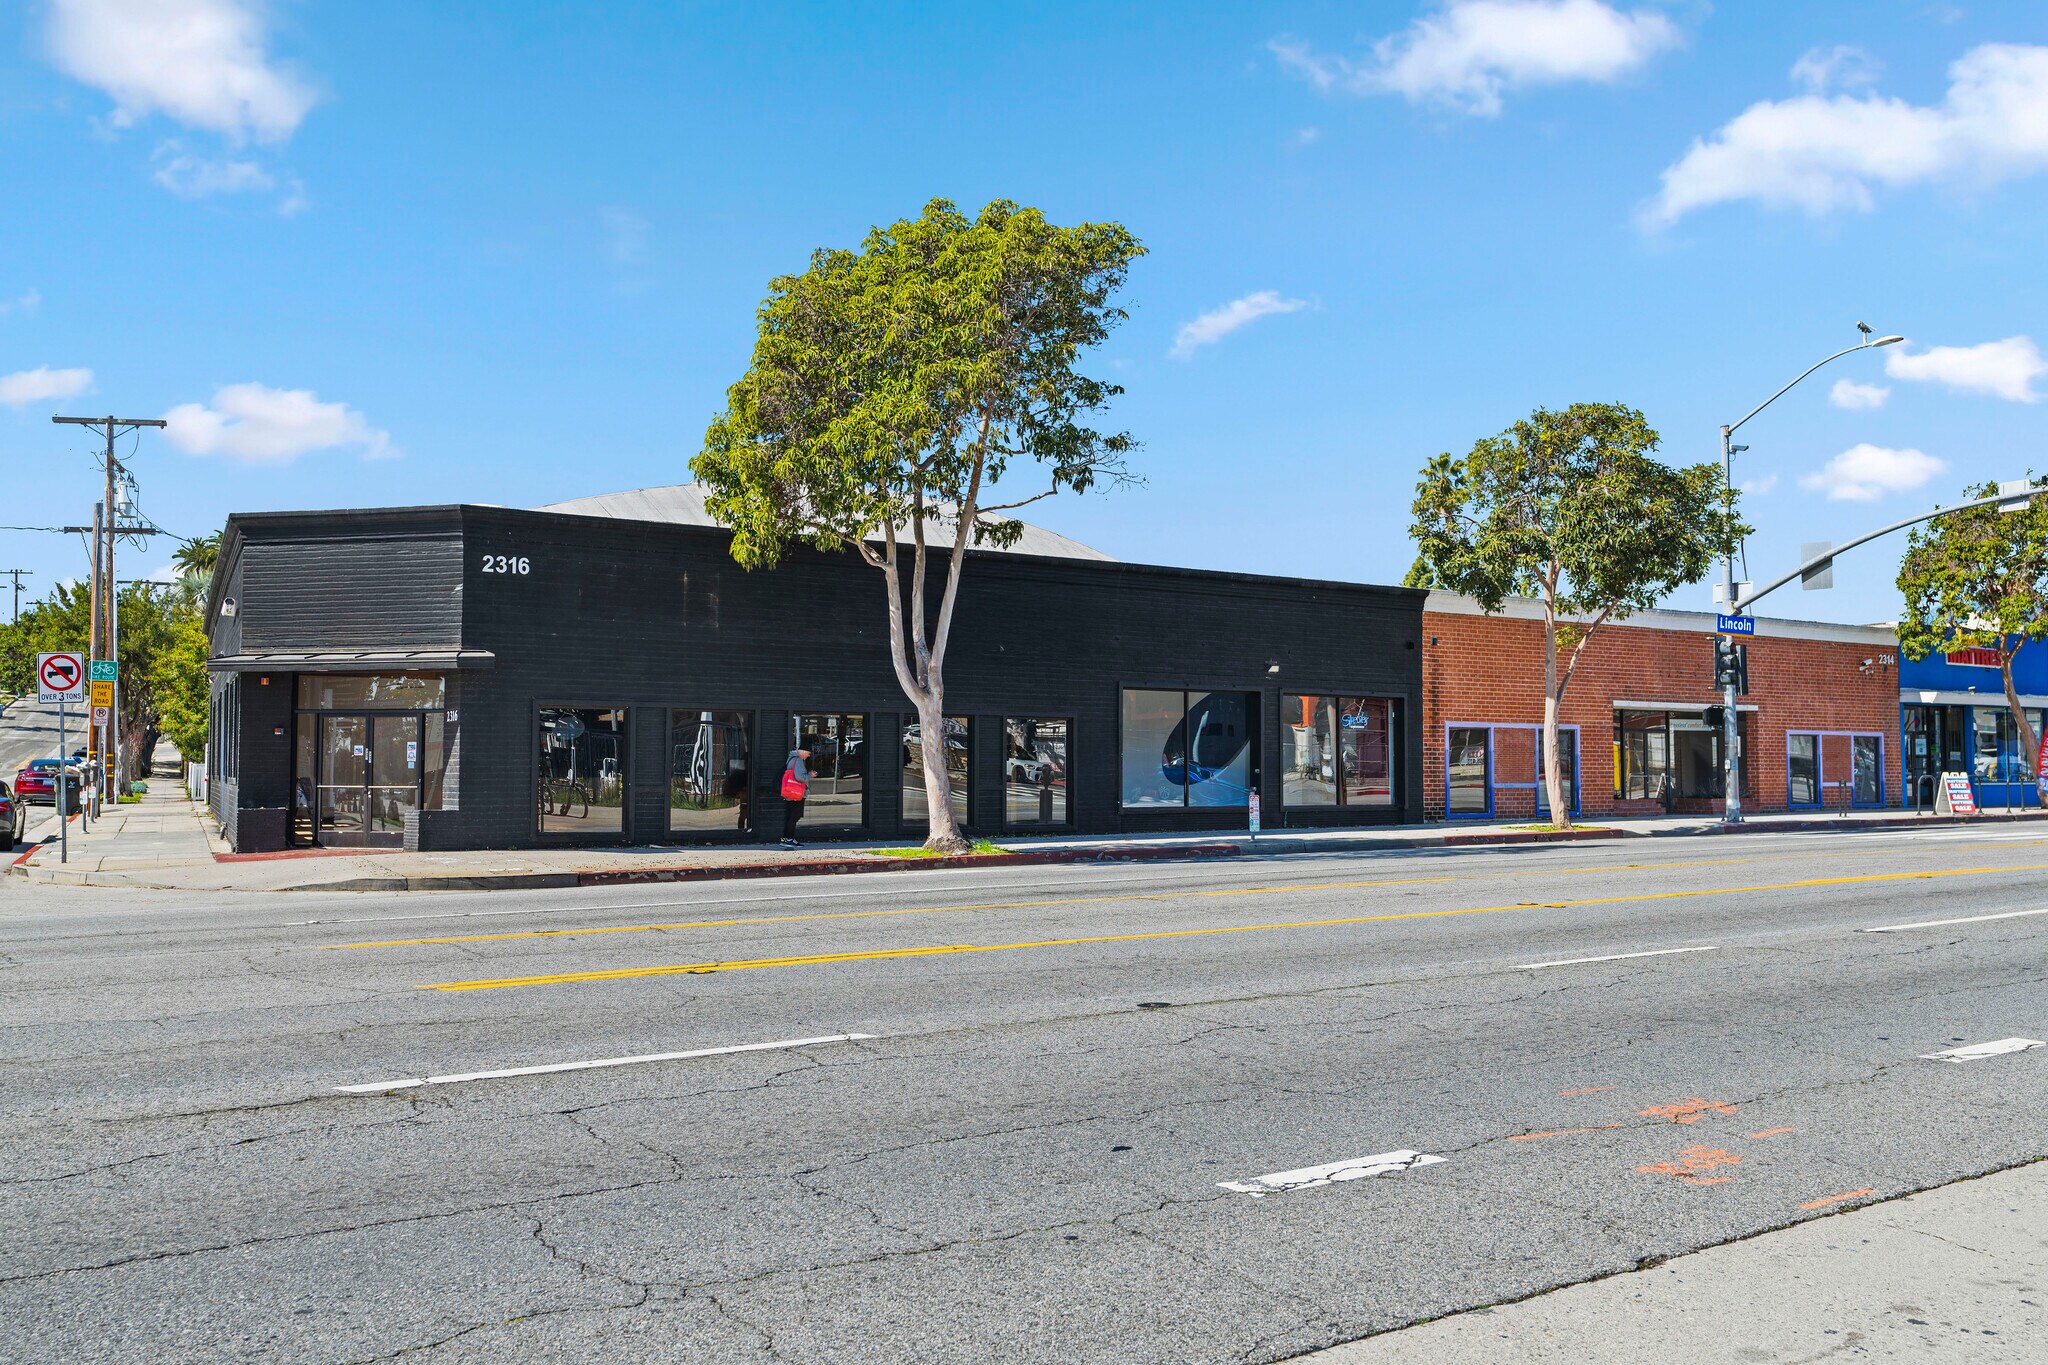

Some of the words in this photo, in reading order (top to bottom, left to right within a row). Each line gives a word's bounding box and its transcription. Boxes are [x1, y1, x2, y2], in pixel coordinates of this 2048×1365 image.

[482, 555, 530, 575] 2316
[1719, 616, 1752, 632] Lincoln
[1878, 654, 1895, 665] 2314
[58, 692, 65, 701] 3
[446, 710, 458, 722] 2316
